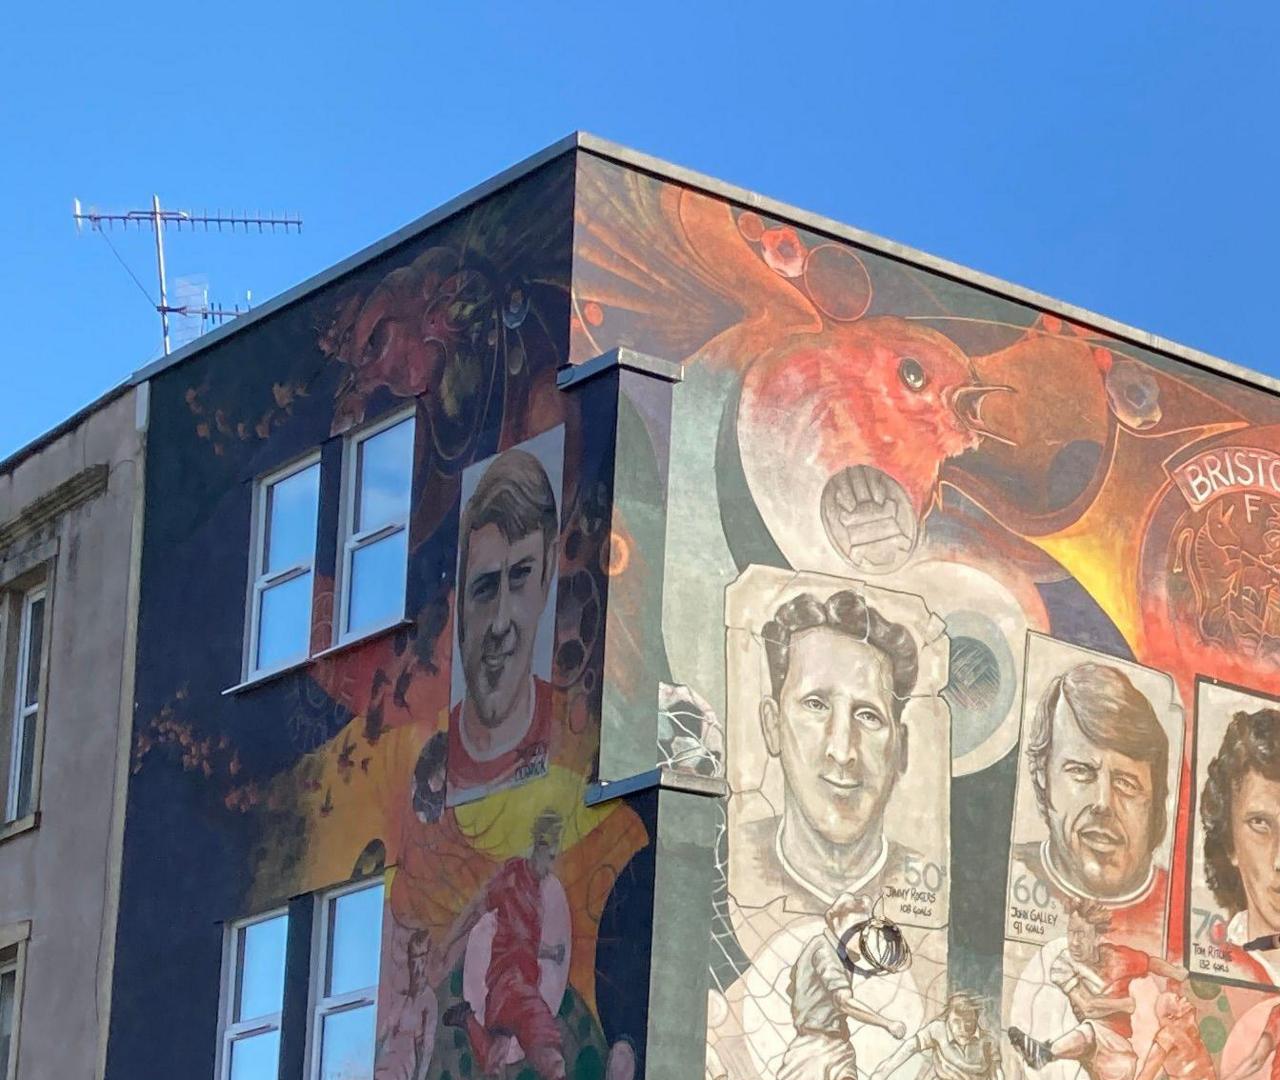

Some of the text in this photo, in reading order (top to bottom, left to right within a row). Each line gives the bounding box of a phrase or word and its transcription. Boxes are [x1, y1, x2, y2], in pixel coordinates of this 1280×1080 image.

[1244, 493, 1262, 523] F
[1029, 908, 1058, 927] GALLEY
[1192, 942, 1206, 957] TOM
